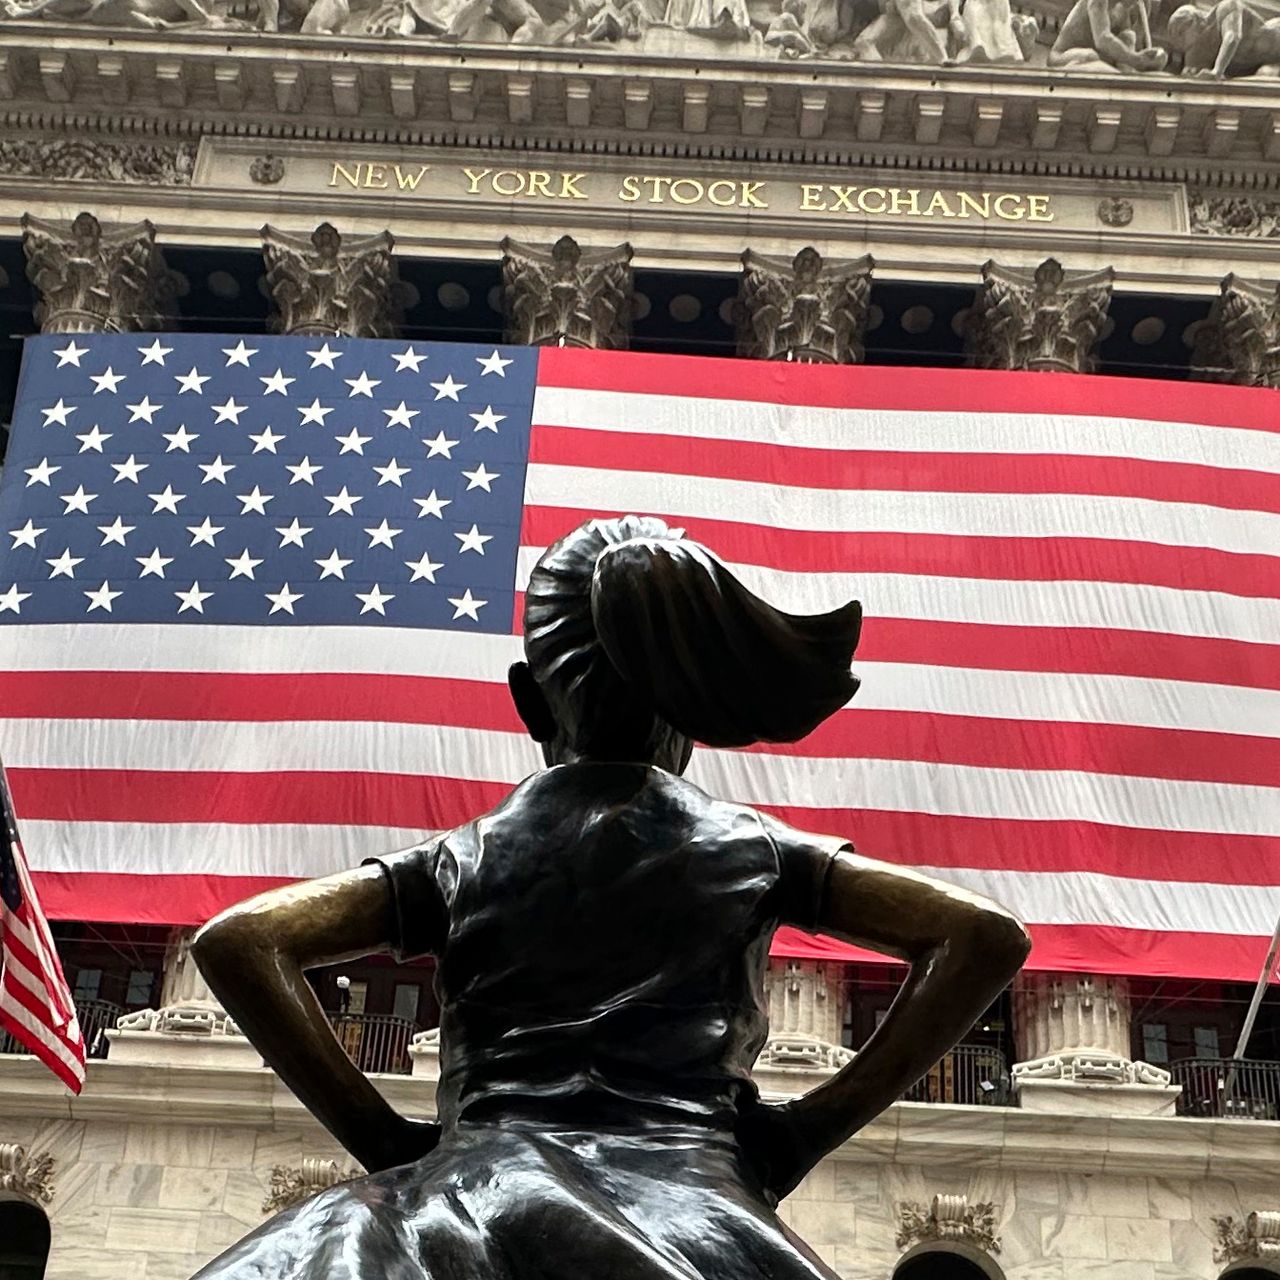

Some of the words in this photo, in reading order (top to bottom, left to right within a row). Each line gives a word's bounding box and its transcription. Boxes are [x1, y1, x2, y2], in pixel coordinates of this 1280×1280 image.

[328, 161, 430, 191] NEW
[461, 167, 589, 200] YORK
[618, 176, 769, 209] STOCK
[799, 184, 1055, 222] EXCHANGE
